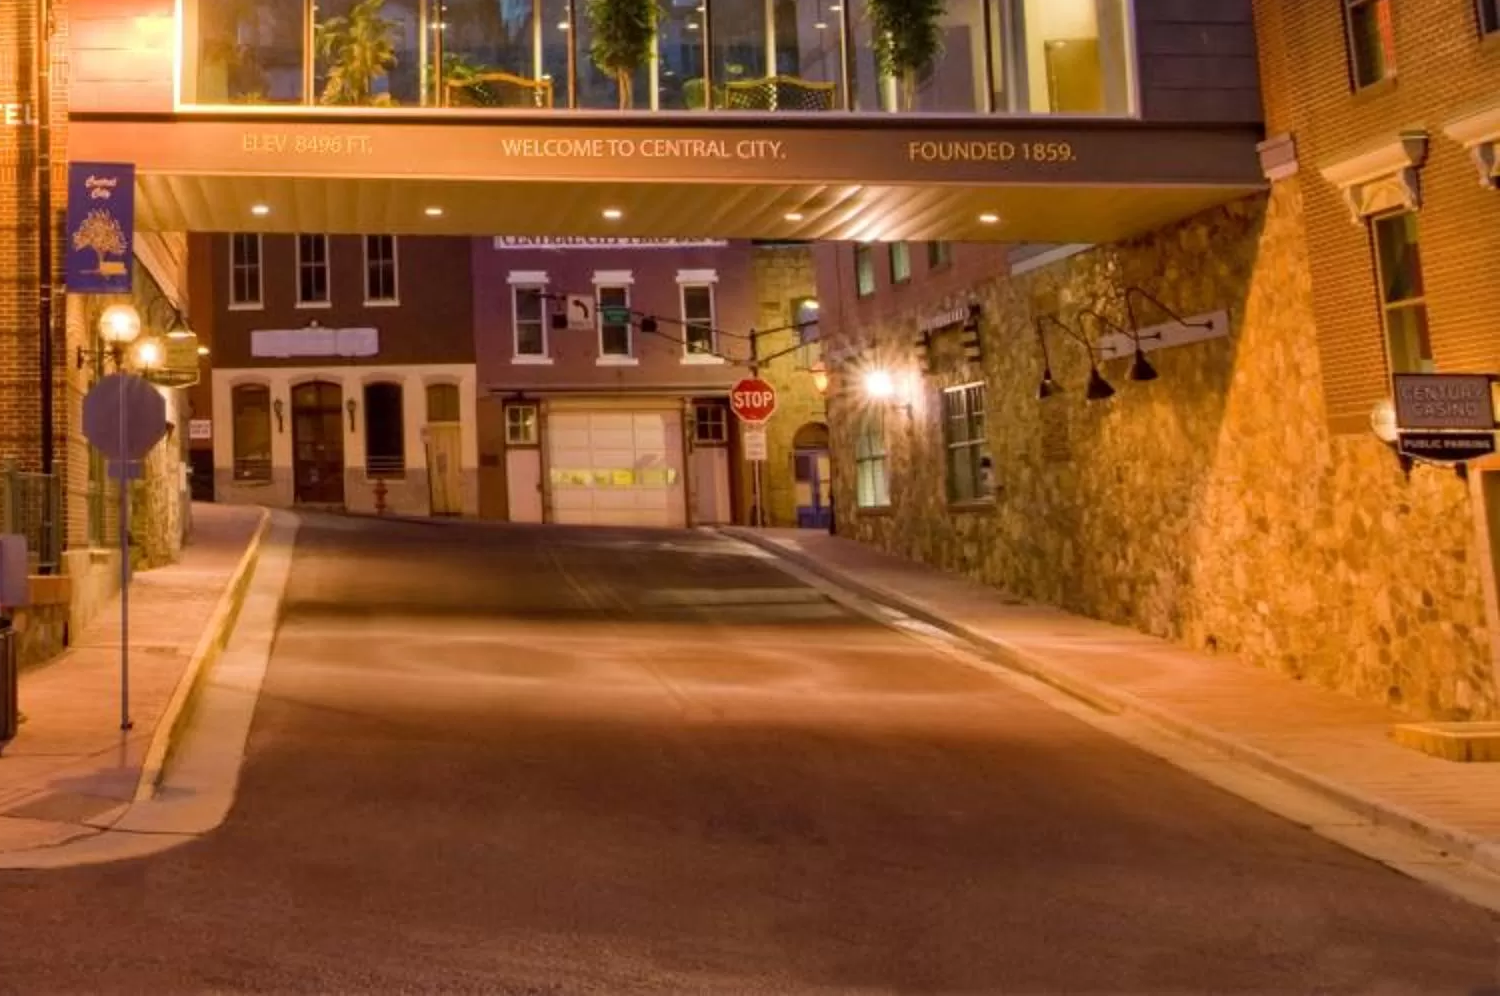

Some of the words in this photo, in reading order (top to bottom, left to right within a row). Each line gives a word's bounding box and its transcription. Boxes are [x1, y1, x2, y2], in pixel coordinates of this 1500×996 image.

[502, 139, 603, 156] WELCOME
[604, 139, 634, 156] TO
[639, 139, 730, 157] CENTRAL
[736, 140, 787, 159] CITY.
[909, 141, 1015, 161] FOUNDED
[1022, 143, 1077, 162] 1859.
[734, 391, 773, 409] STOP
